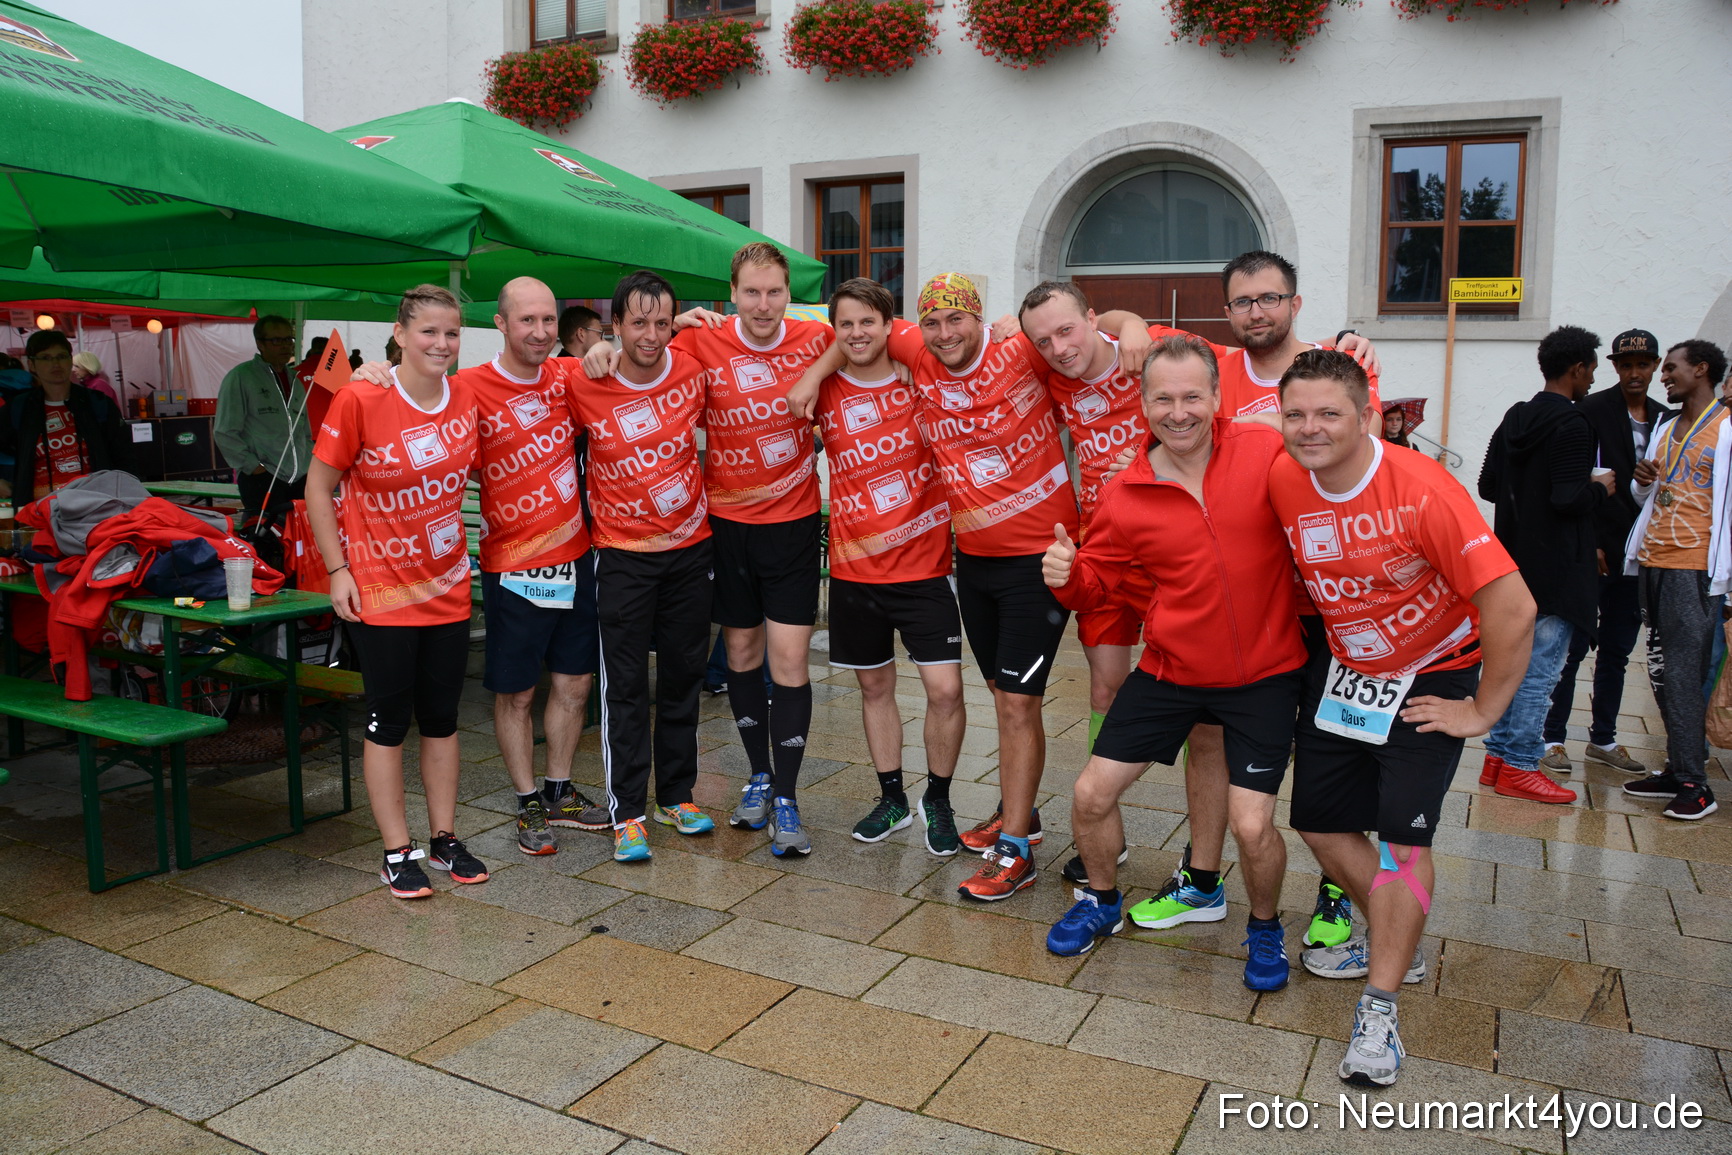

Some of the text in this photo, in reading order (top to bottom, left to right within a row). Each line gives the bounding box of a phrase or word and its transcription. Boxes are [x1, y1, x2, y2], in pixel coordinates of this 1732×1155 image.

[325, 348, 338, 372] THULE
[968, 337, 1023, 397] raum
[976, 373, 1012, 403] schenken
[616, 399, 649, 417] raumbox
[843, 395, 871, 409] raumbox
[404, 426, 436, 441] raumbox
[486, 431, 516, 449] outdoor
[736, 423, 770, 438] wohnen
[760, 431, 793, 446] raumbox
[945, 421, 1012, 450] wohnen outdoor
[481, 416, 575, 487] raumbox
[967, 449, 997, 462] raumbox
[1015, 444, 1050, 471] schenken
[726, 467, 757, 477] outdoor
[848, 464, 878, 480] wohnen
[884, 449, 917, 467] outdoor
[488, 476, 523, 496] schenken
[528, 455, 557, 476] wohnen
[626, 471, 659, 488] wohnen
[770, 461, 811, 495] raumbox
[869, 473, 901, 490] raumbox
[355, 464, 470, 513] raumbox
[403, 504, 439, 522] wohnen
[986, 487, 1041, 519] raumbox
[429, 513, 458, 533] raumbox
[525, 504, 557, 525] outdoor
[668, 507, 704, 542] raumbox
[1300, 516, 1333, 528] raumbox
[883, 514, 931, 545] raumbox
[502, 522, 570, 561] Team
[1348, 539, 1397, 559] schenken
[510, 561, 572, 580] 34
[362, 577, 439, 608] Team
[524, 585, 556, 598] Tobias
[1349, 592, 1390, 613] outdoor
[1337, 622, 1373, 636] raumbox
[1398, 609, 1446, 647] schenken
[1001, 668, 1019, 677] Reebok
[1331, 663, 1402, 709] 2355
[1341, 709, 1366, 727] Claus
